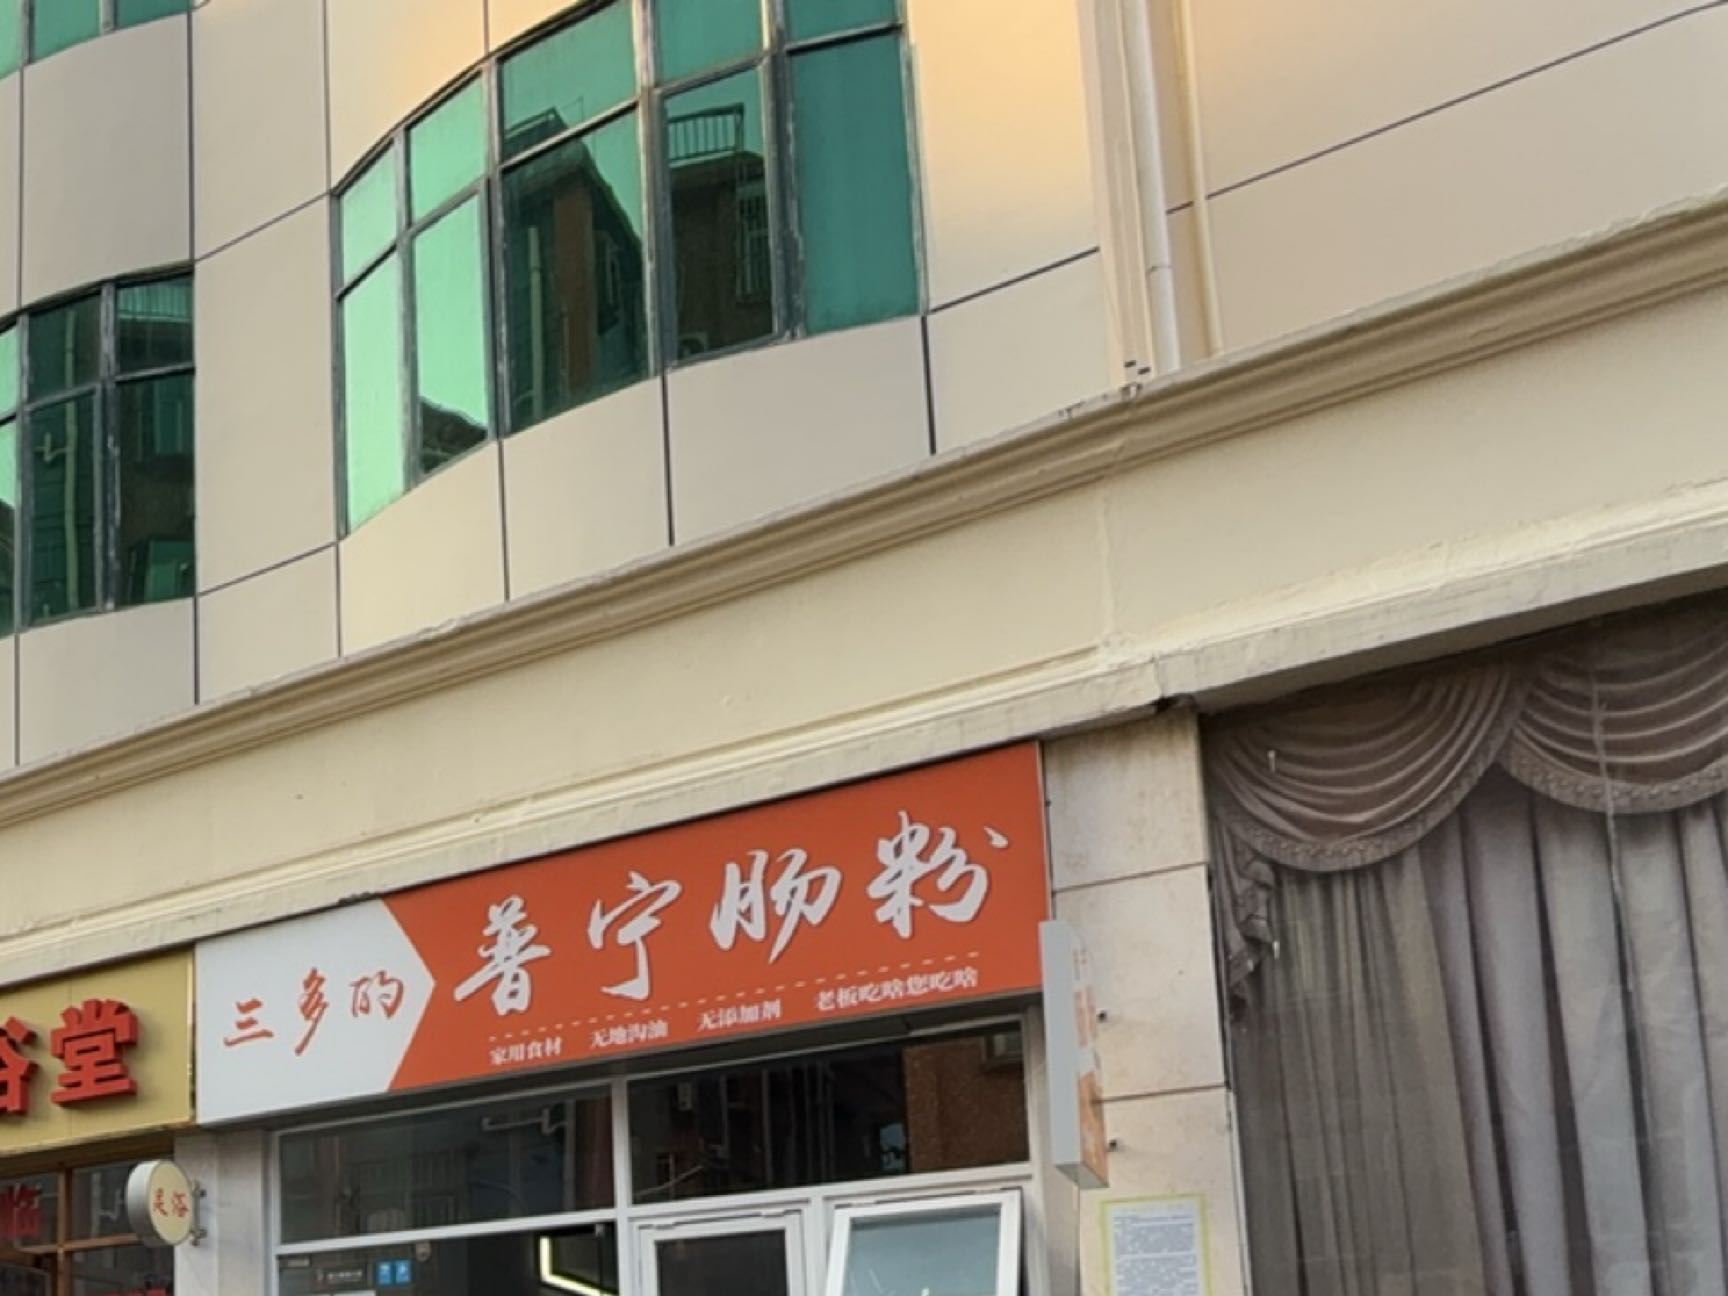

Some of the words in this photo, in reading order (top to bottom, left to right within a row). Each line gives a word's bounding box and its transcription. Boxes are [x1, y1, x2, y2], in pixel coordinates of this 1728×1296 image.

[454, 811, 1009, 1016] 普宁肠粉
[222, 967, 404, 1056] 三多的
[590, 1018, 668, 1050] 无地沟油
[698, 998, 782, 1032] 无添加剂
[816, 966, 979, 1013] 老板吃啥您吃啥
